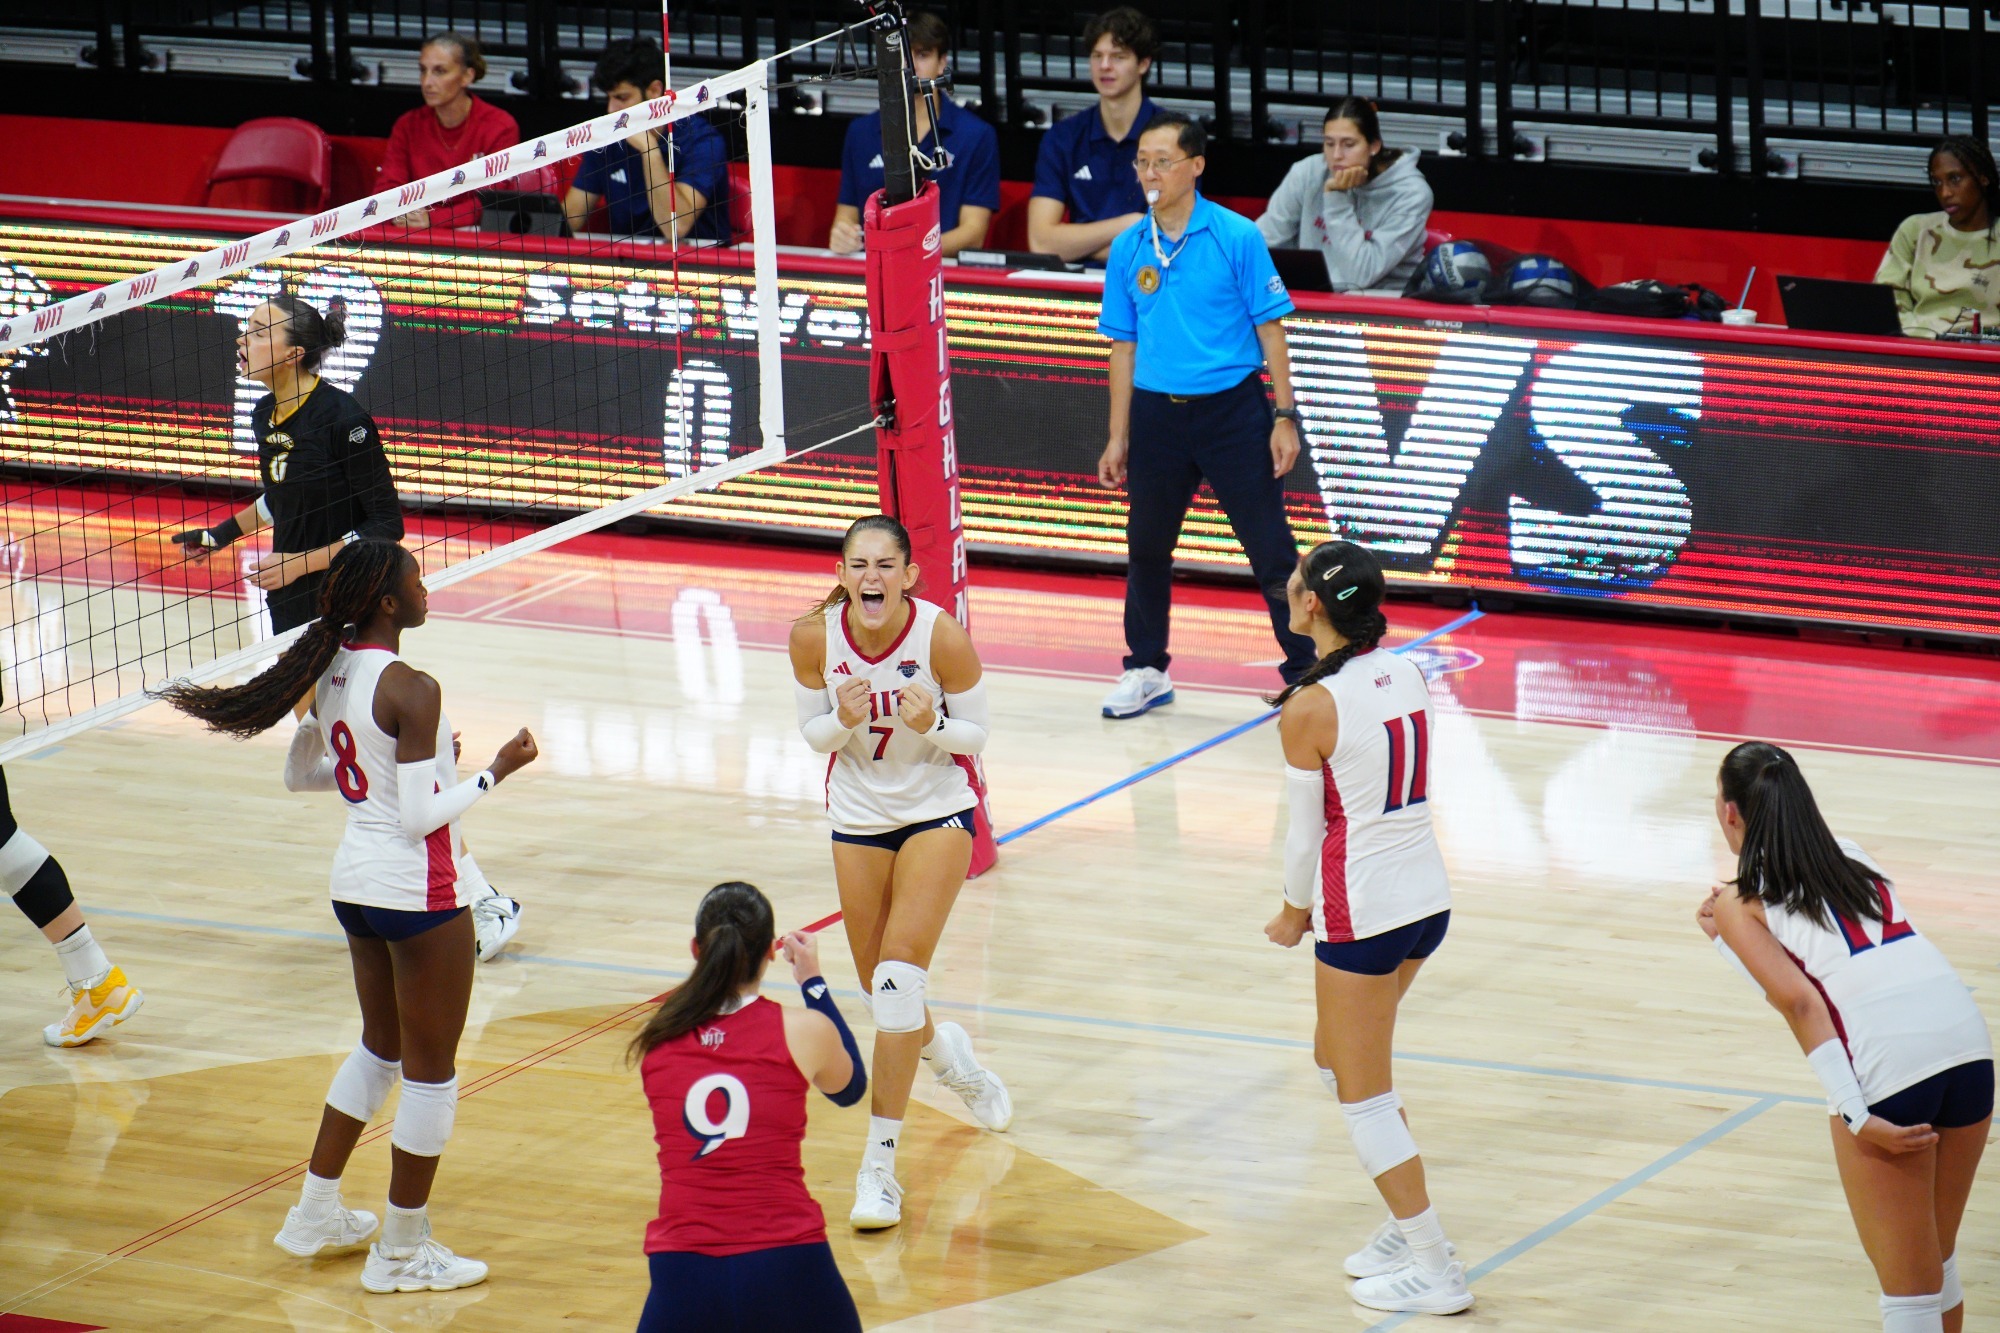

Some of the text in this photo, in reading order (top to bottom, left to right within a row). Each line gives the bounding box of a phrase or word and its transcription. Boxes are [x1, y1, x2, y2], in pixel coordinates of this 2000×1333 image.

[566, 123, 592, 148] NJIT
[484, 152, 511, 178] NJIT
[397, 180, 427, 207] NJIT
[309, 210, 340, 238] NJIT
[219, 241, 251, 269] NJIT
[126, 273, 159, 300] NJIT
[32, 304, 65, 333] NJIT
[1281, 320, 1706, 580] VS
[869, 725, 894, 761] 7
[331, 719, 369, 804] 8
[1382, 708, 1428, 815] 11
[682, 1072, 751, 1162] 9
